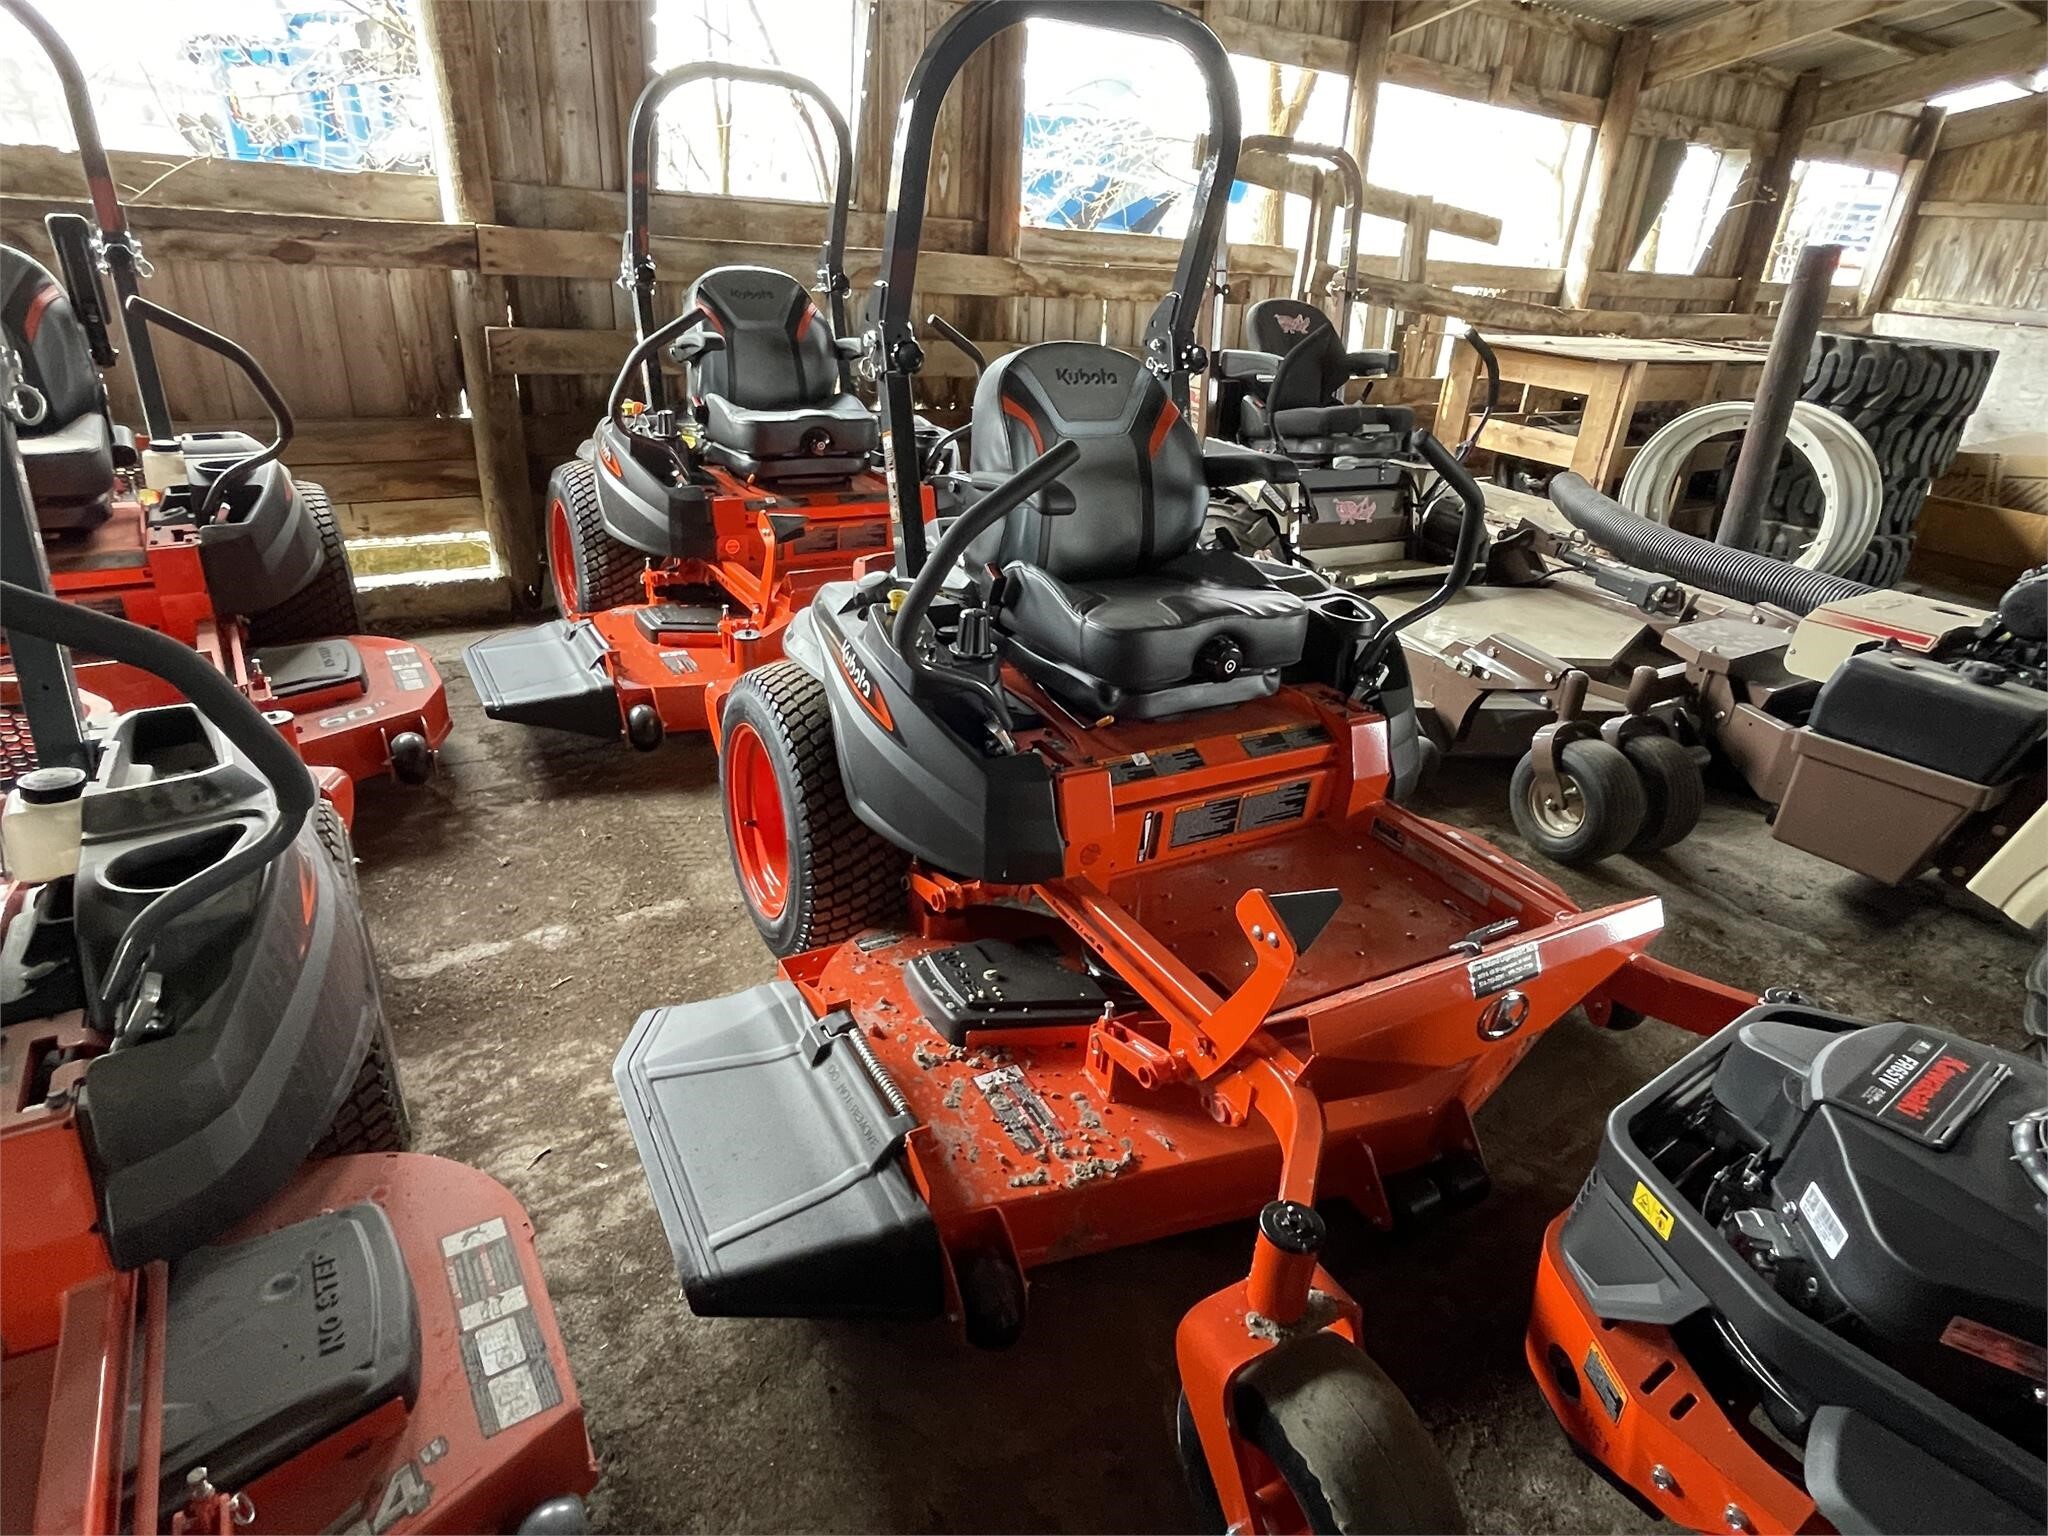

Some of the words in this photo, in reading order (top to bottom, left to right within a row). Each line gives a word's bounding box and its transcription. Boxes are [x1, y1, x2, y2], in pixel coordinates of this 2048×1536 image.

[1055, 367, 1118, 386] Kubota
[841, 639, 871, 698] Kubota
[1878, 1054, 1920, 1090] FR651V
[1896, 1055, 1971, 1120] Kawasaki
[318, 1316, 346, 1358] NO
